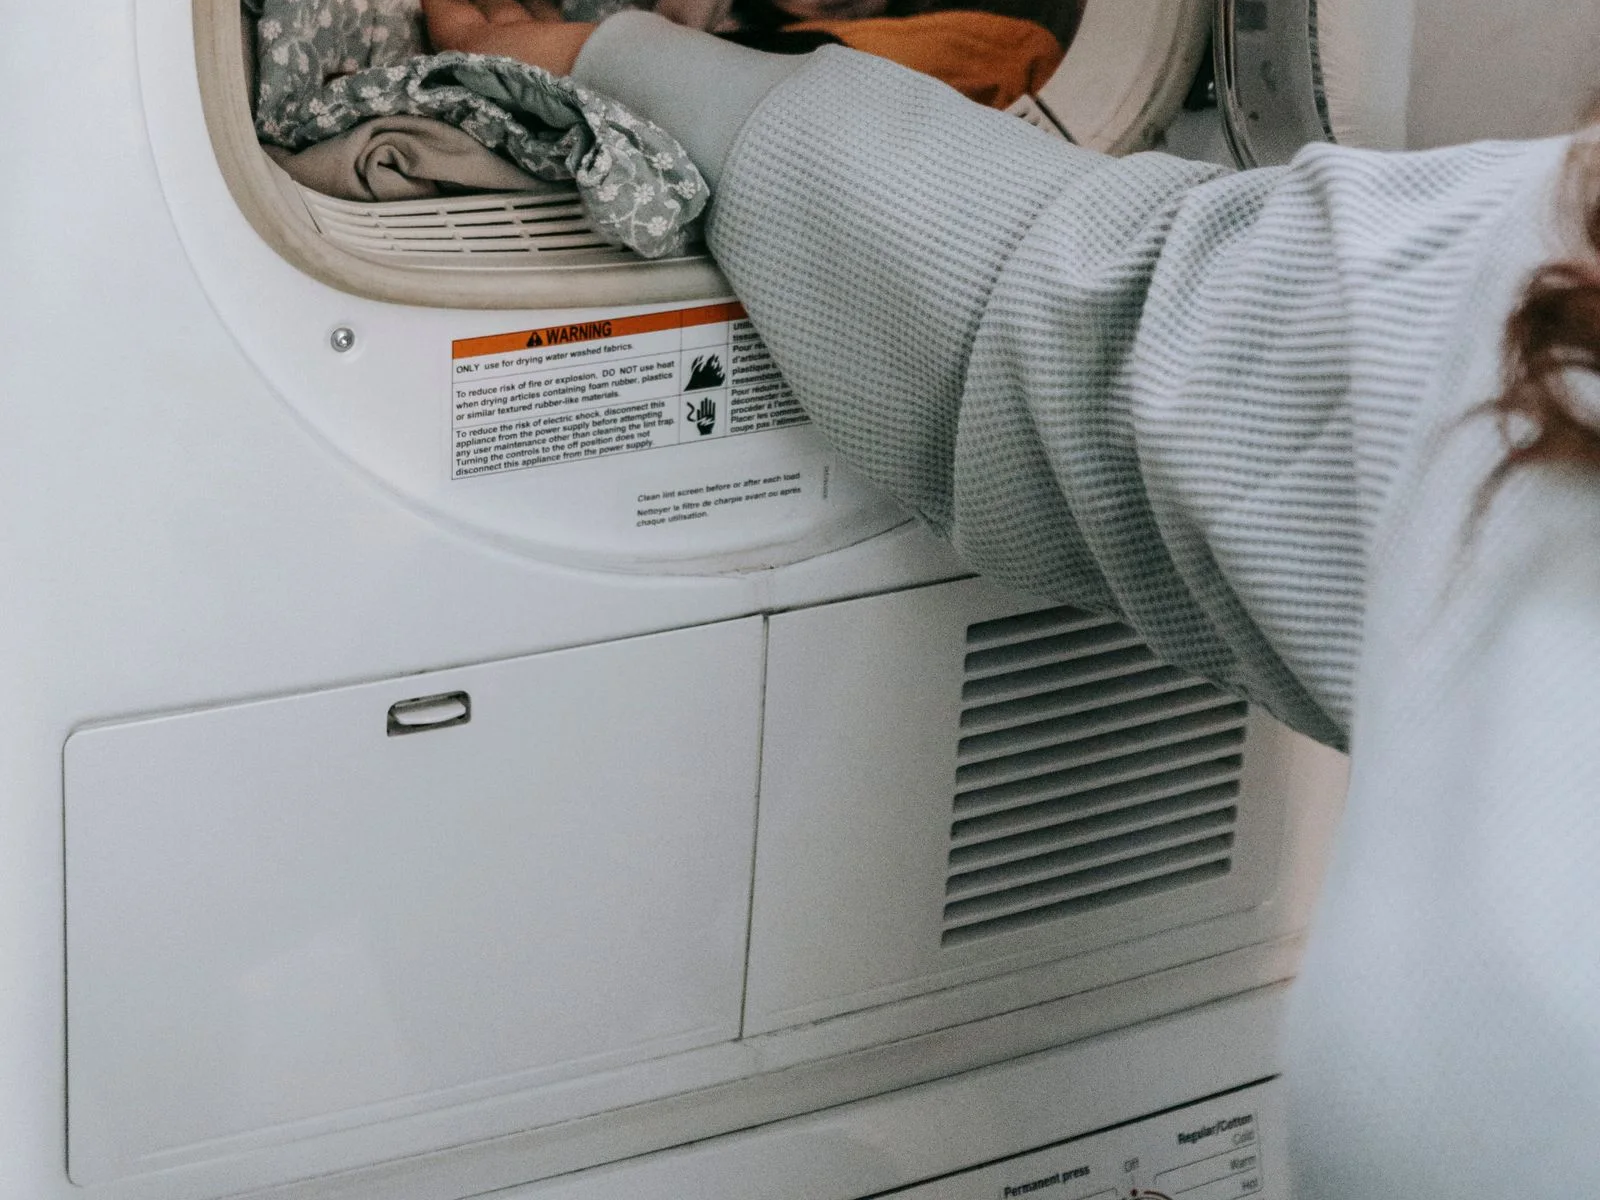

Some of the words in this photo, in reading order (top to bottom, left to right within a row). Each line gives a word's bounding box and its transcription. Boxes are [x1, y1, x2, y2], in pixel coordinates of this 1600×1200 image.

[546, 322, 612, 344] WARNING
[456, 364, 480, 374] ONLY
[484, 362, 500, 370] use
[502, 359, 514, 368] for
[516, 356, 543, 366] drying
[546, 352, 568, 360] water
[570, 346, 602, 358] washed
[456, 390, 466, 398] To
[468, 386, 498, 396] reduce
[500, 383, 516, 393] risk
[518, 380, 526, 389] of
[528, 380, 542, 388] fire
[602, 368, 616, 378] DO
[619, 365, 638, 374] NOT
[640, 364, 654, 372] use
[656, 360, 675, 370] heat
[456, 401, 479, 410] when
[480, 396, 508, 407] drying
[510, 391, 540, 402] articles
[542, 385, 586, 398] containing
[588, 381, 610, 390] foam
[642, 372, 673, 384] plastics
[456, 430, 467, 438] To
[469, 426, 498, 436] reduce
[500, 424, 513, 432] the
[515, 421, 530, 430] risk
[532, 418, 542, 426] of
[543, 414, 573, 426] electric
[604, 403, 648, 416] disconnect
[650, 401, 665, 409] this
[466, 409, 496, 419] similar
[498, 404, 532, 414] textured
[534, 396, 578, 409] rubber-like
[456, 436, 496, 448] appliance
[498, 433, 518, 441] from
[520, 430, 533, 438] the
[535, 426, 560, 436] power
[562, 422, 590, 432] supply
[592, 418, 618, 428] before
[620, 411, 662, 423] attempting
[456, 450, 470, 458] any
[473, 447, 492, 455] user
[494, 438, 546, 452] maintenance
[548, 434, 570, 443] other
[572, 431, 591, 440] than
[592, 426, 626, 437] cleaning
[628, 422, 641, 430] the
[644, 420, 656, 428] lint
[730, 424, 754, 432] coupe
[456, 456, 489, 466] Turning
[490, 453, 504, 461] the
[506, 448, 540, 458] controls
[552, 443, 566, 452] the
[567, 442, 579, 450] off
[580, 436, 614, 448] position
[616, 434, 635, 442] does
[637, 430, 651, 438] not
[456, 464, 502, 476] disconnect
[504, 460, 519, 469] this
[522, 454, 561, 466] appliance
[563, 451, 582, 460] from
[584, 448, 596, 456] the
[599, 444, 624, 454] power
[637, 494, 660, 502] Clean
[662, 490, 676, 500] lint
[677, 487, 704, 497] screen
[706, 483, 731, 494] before
[743, 478, 761, 487] after
[762, 476, 782, 484] each
[637, 506, 672, 517] Nettoyer
[674, 504, 680, 512] le
[682, 502, 700, 510] filtre
[702, 500, 712, 508] de
[714, 495, 743, 506] charpie
[745, 492, 767, 501] avant
[768, 490, 778, 498] ou
[636, 516, 666, 528] chaque
[1004, 1173, 1060, 1199] Permanent
[1062, 1165, 1090, 1184] press
